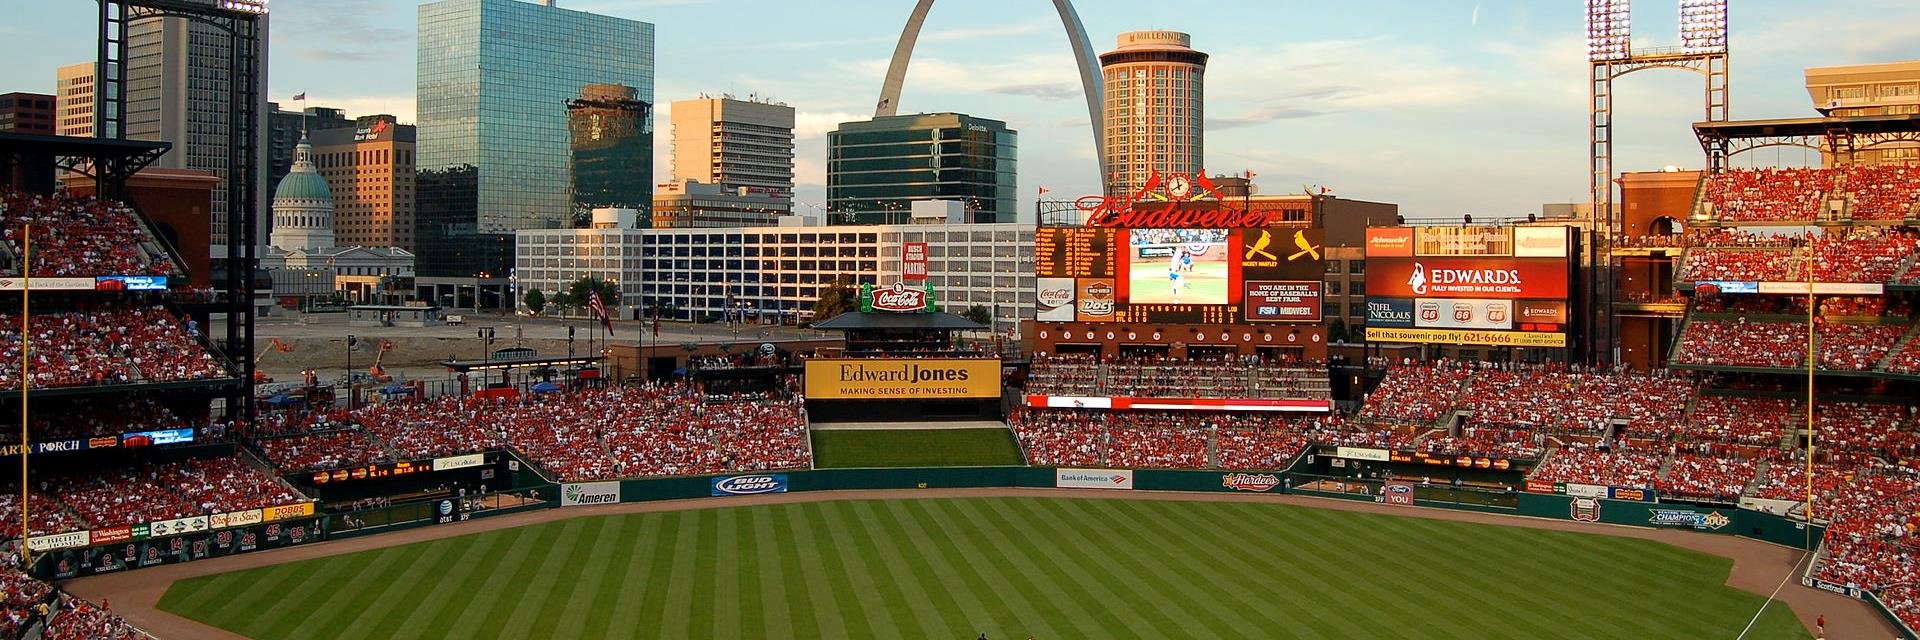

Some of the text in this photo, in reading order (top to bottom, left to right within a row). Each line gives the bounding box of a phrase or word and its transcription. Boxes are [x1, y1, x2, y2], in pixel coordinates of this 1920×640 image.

[1075, 195, 1282, 228] Budweiser
[904, 262, 926, 275] PARKING
[879, 291, 920, 308] Coca-Cola
[1041, 289, 1072, 299] Coca-Cola
[1259, 307, 1277, 315] FSN
[1368, 302, 1392, 311] STIFEL
[1370, 309, 1411, 319] NICOLAUS
[1423, 310, 1437, 319] 66
[1456, 311, 1470, 319] 66
[1489, 312, 1504, 320] 66
[1382, 331, 1398, 339] that
[1399, 332, 1431, 340] souvenir
[1449, 333, 1461, 342] fly!
[1463, 333, 1512, 343] 621-6666
[840, 364, 969, 384] Edward Jones
[878, 387, 906, 395] SENSE
[909, 387, 920, 395] OF
[922, 387, 968, 395] INVESTING
[39, 440, 80, 453] PORCH
[734, 476, 773, 485] BUD
[1084, 474, 1108, 482] America
[728, 482, 777, 490] LIGHT
[578, 493, 616, 504] Ameren
[1391, 495, 1409, 504] YOU
[275, 505, 304, 515] DOBBS
[240, 511, 260, 522] Save
[98, 528, 130, 537] Washington
[266, 524, 280, 537] 45
[217, 531, 232, 544] 20
[242, 533, 256, 546] 42
[170, 537, 183, 551] 14
[193, 540, 205, 553] 17
[126, 544, 135, 557] 6
[147, 547, 157, 560] 9
[84, 550, 89, 563] 1
[102, 554, 112, 568] 2
[1816, 582, 1846, 594] Scottrade
